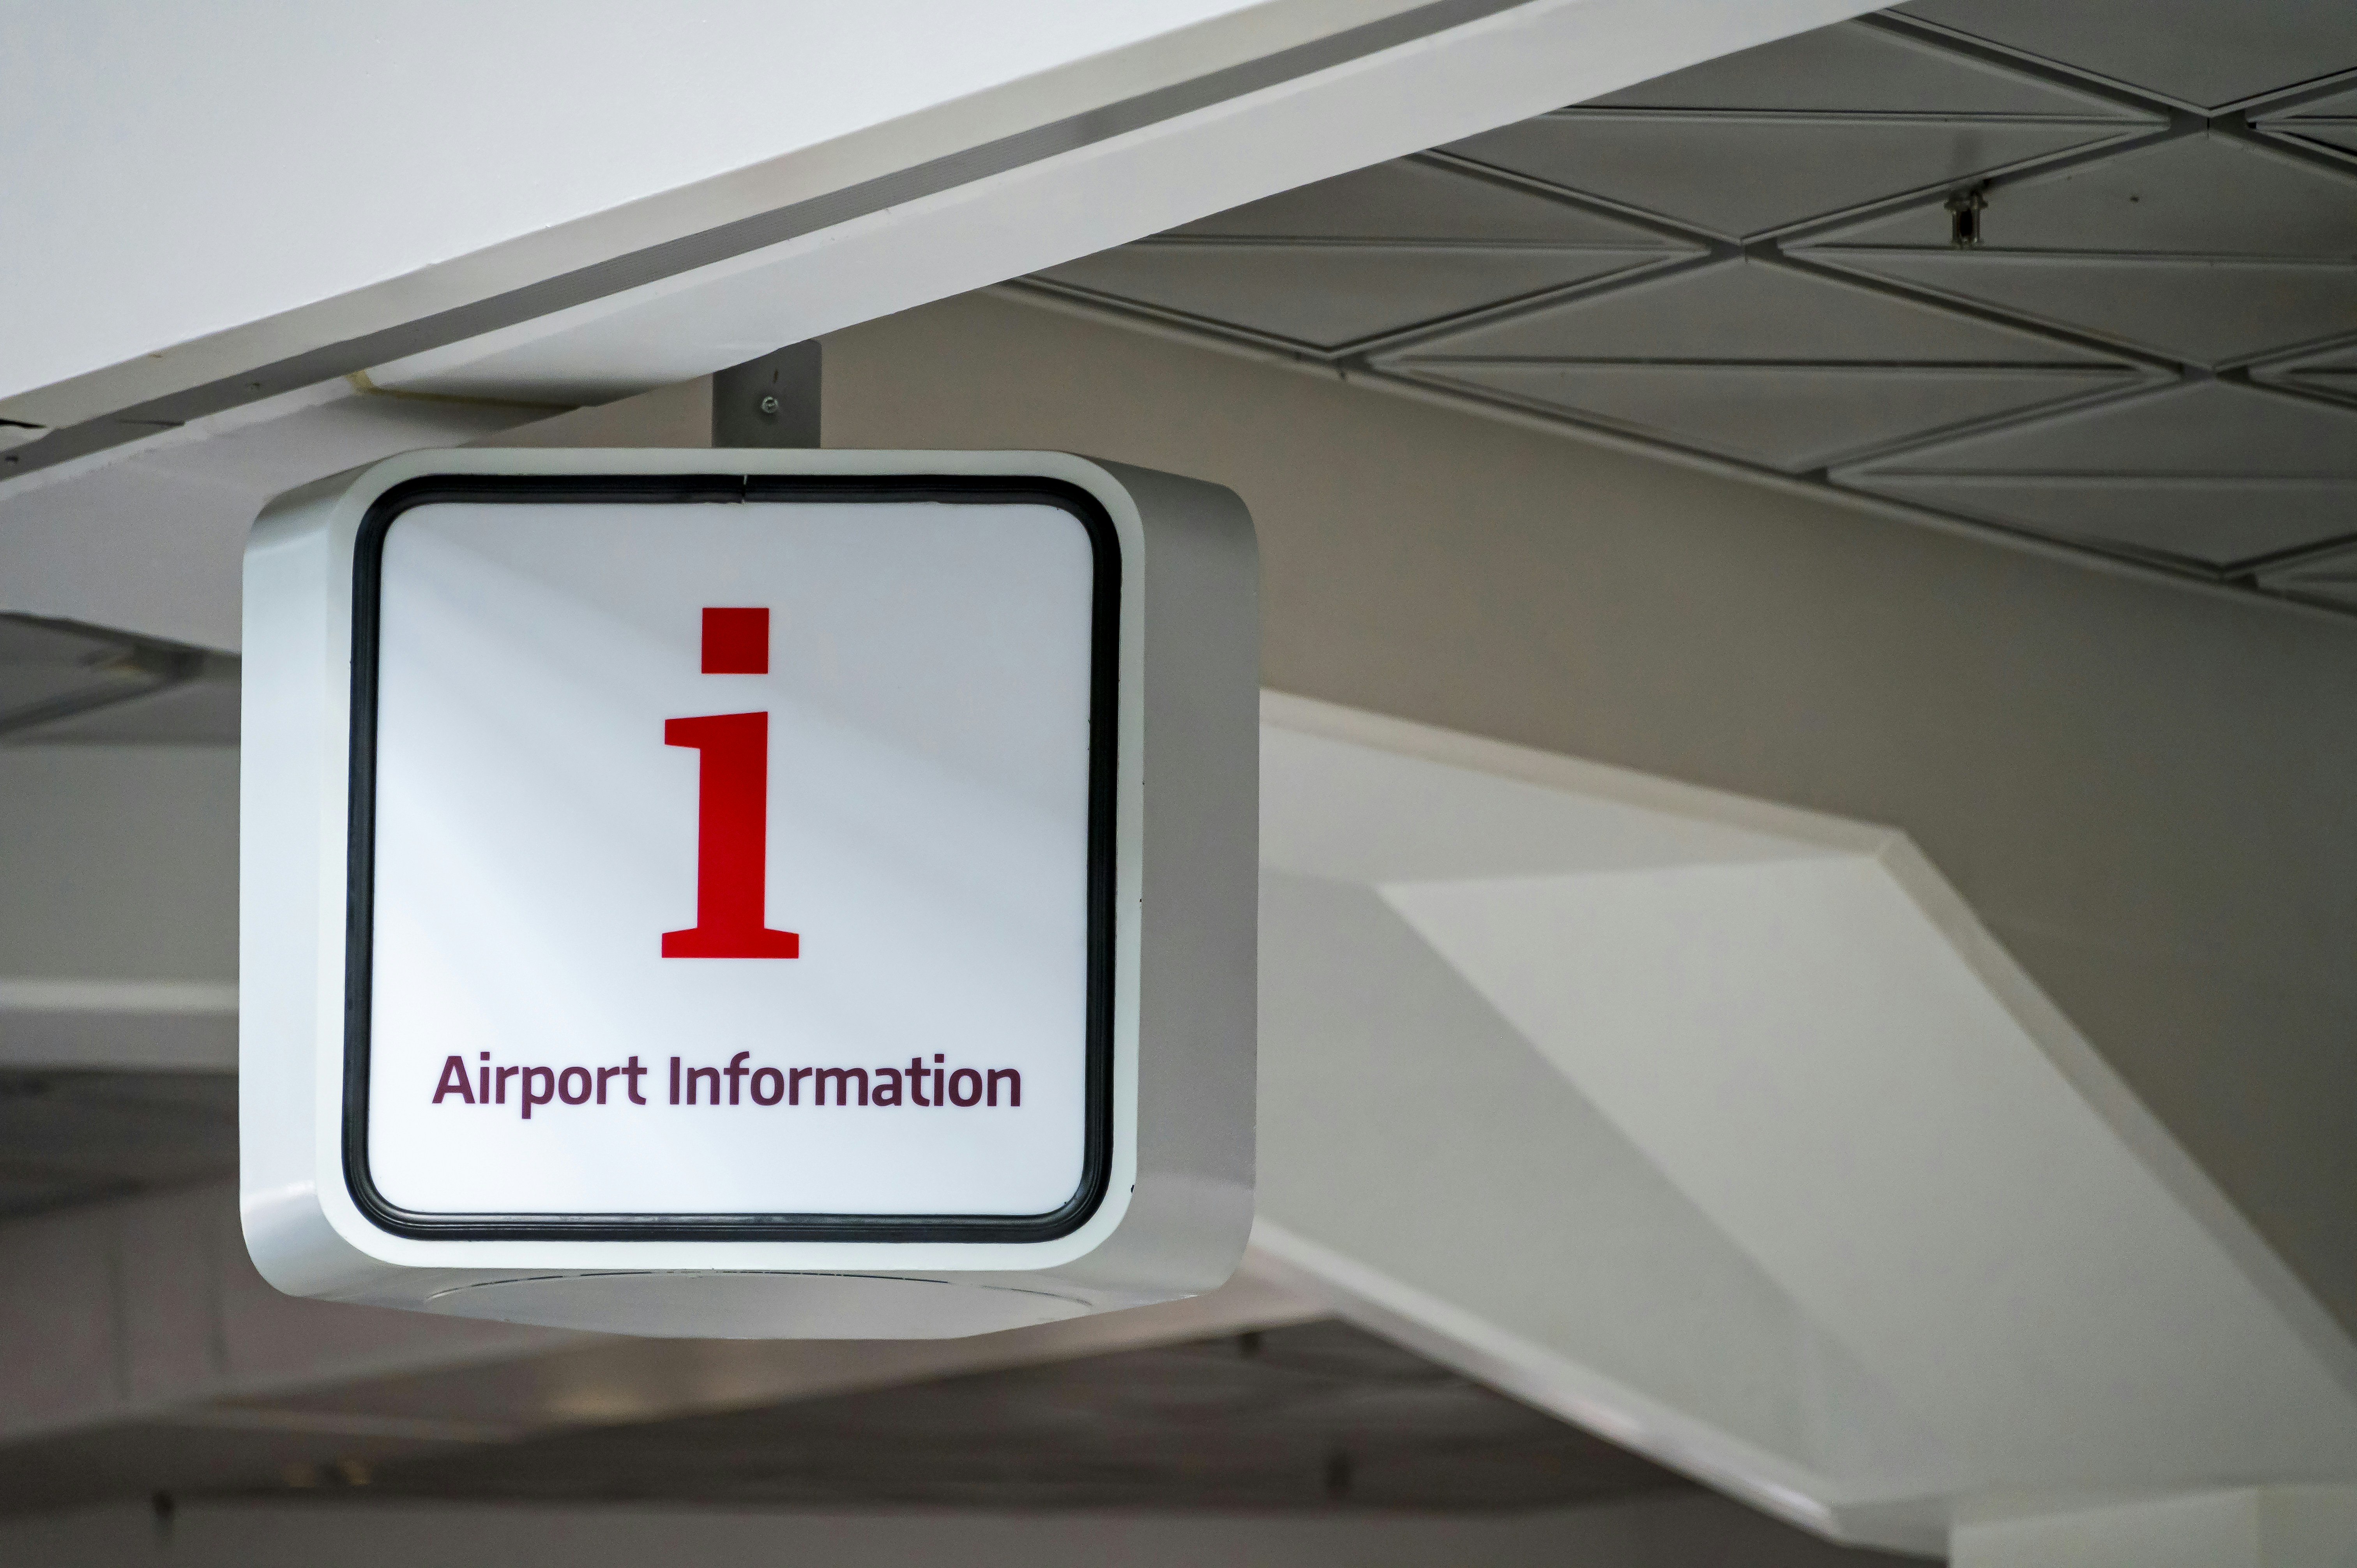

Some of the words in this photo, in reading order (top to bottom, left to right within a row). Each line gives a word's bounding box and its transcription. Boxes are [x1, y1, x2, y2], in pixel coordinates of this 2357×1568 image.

[661, 607, 800, 959] i
[432, 1051, 648, 1119] Airport
[669, 1051, 1021, 1107] Information
